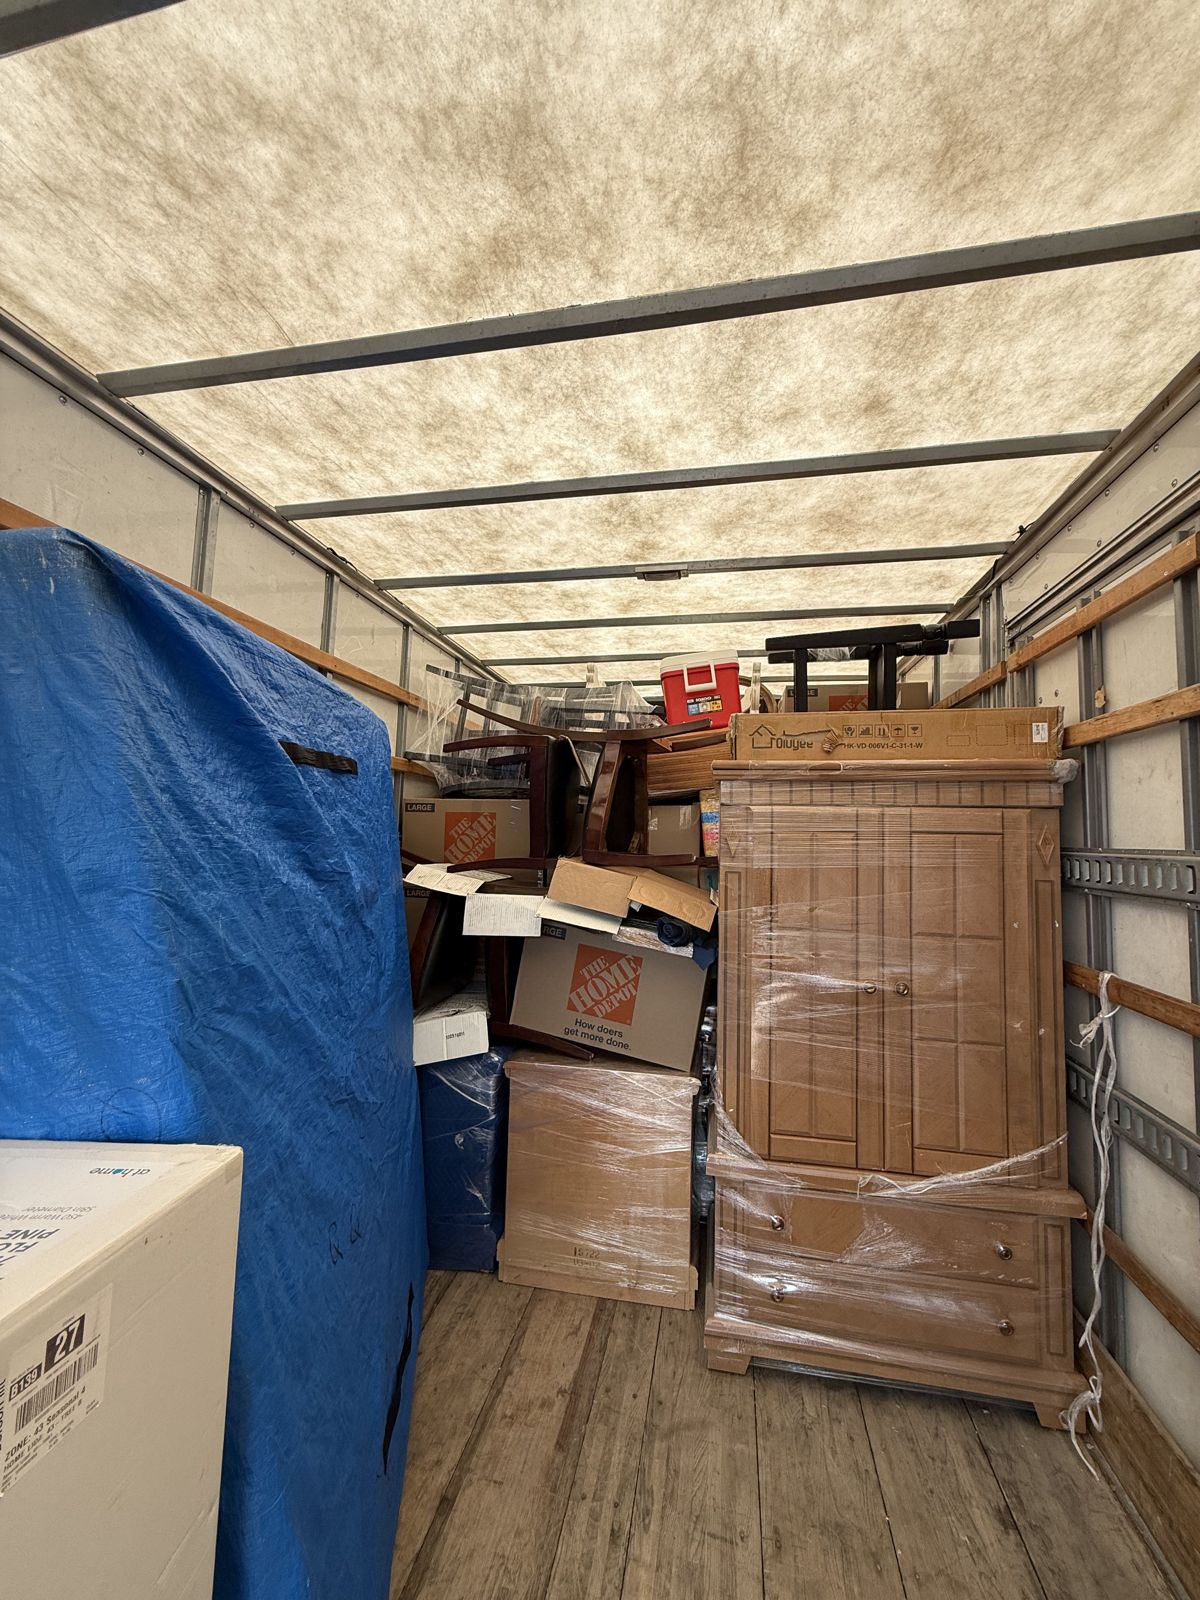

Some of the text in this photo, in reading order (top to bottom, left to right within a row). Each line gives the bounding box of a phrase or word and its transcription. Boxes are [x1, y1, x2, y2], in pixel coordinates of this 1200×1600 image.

[444, 812, 497, 864] HOME
[449, 817, 472, 839] THE
[406, 889, 431, 897] LARGE
[580, 955, 609, 980] THE
[569, 955, 642, 1013] HOME
[593, 980, 638, 1018] DEPOT
[564, 1026, 632, 1051] get more done.
[574, 1018, 624, 1038] How doers
[0, 1228, 60, 1240] PINE
[54, 1319, 81, 1364] 27
[11, 1368, 38, 1398] B139
